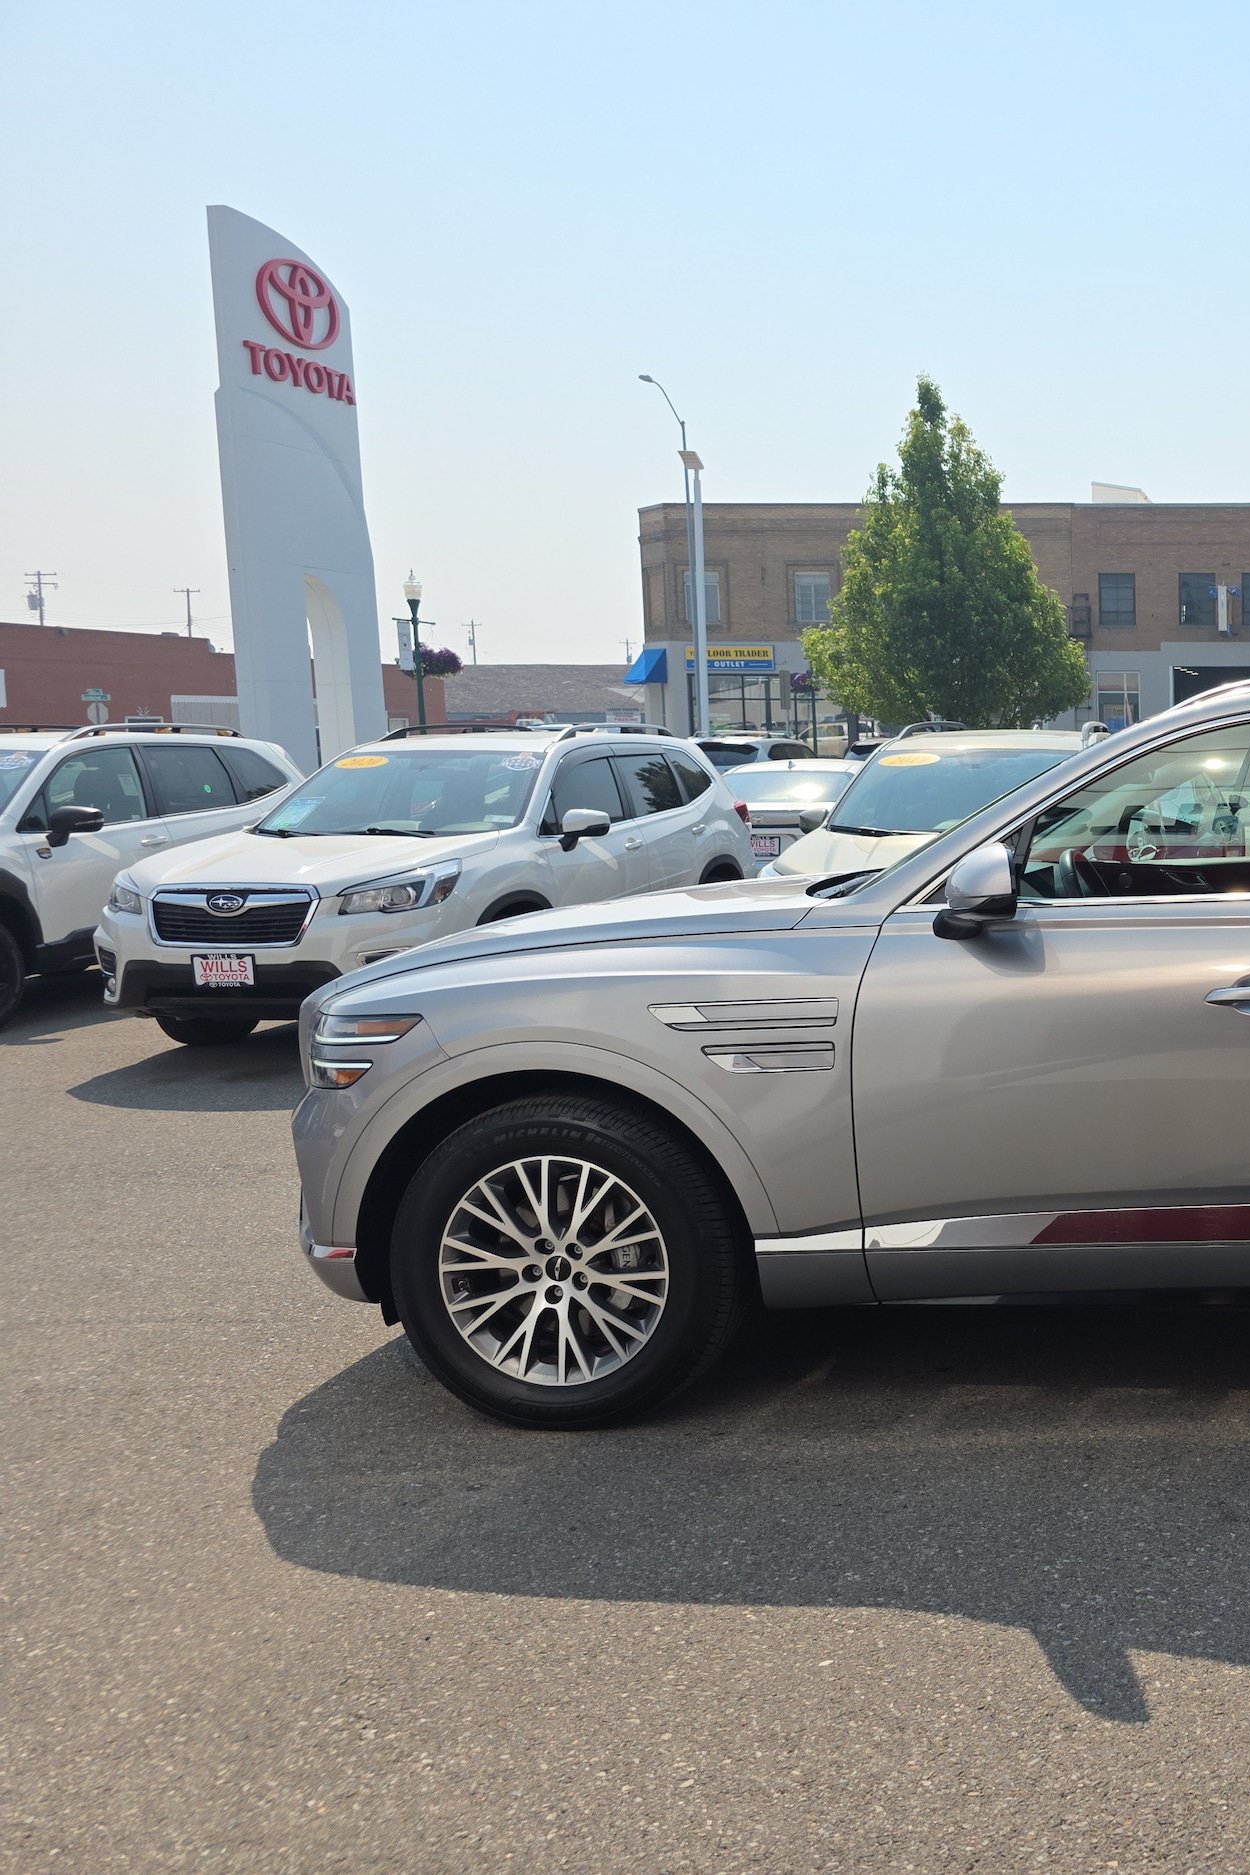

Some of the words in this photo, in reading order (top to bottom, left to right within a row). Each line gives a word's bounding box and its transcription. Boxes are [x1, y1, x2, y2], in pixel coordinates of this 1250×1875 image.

[242, 340, 356, 405] TOYOTA
[200, 960, 248, 973] WILLS
[493, 1127, 583, 1144] MICHELIN
